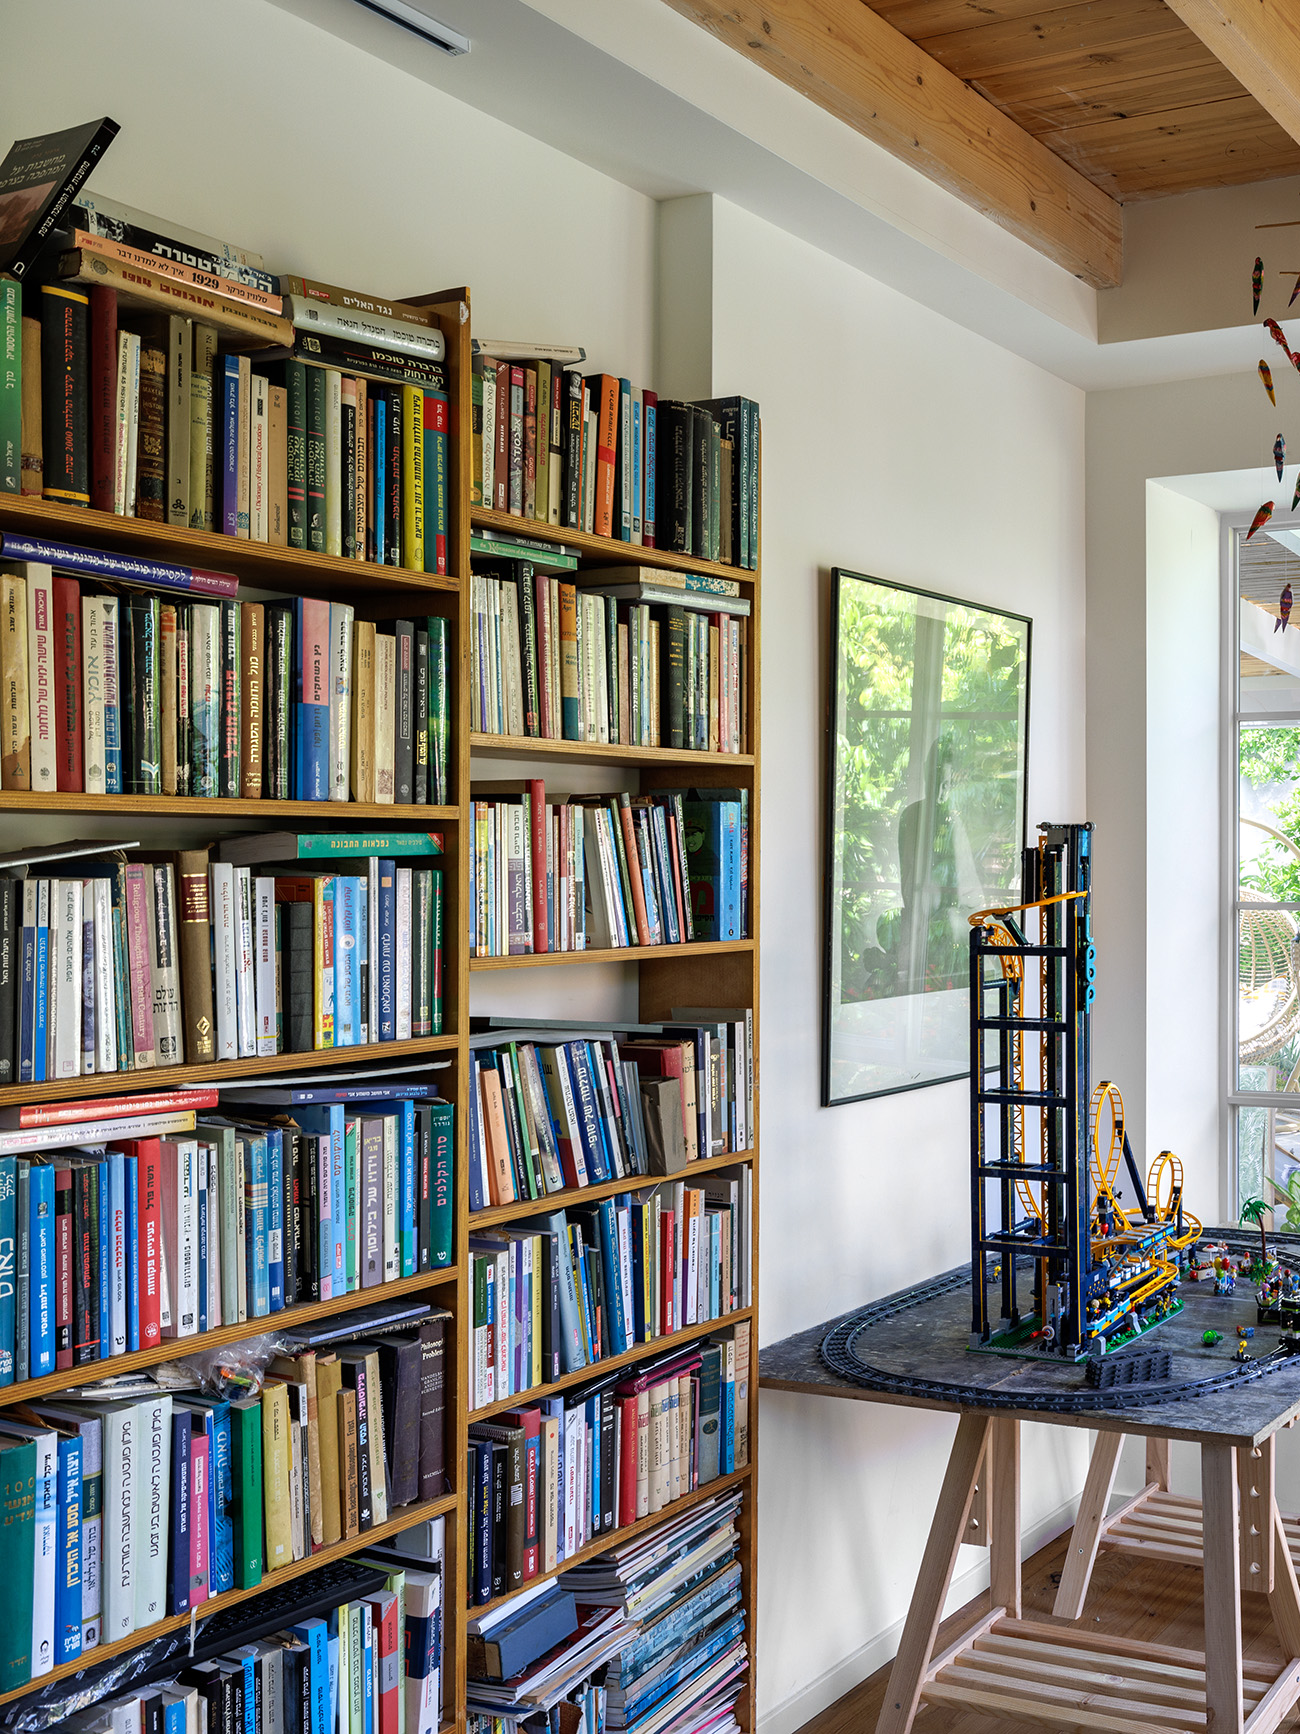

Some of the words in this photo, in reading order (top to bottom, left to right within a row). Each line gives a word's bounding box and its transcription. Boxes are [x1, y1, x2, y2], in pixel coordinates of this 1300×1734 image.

[71, 160, 90, 185] מחשבות
[68, 184, 75, 193] על
[51, 193, 70, 217] המהפכה
[38, 216, 54, 237] בצרפת
[117, 249, 132, 257] דבר
[134, 254, 156, 268] למדנו
[159, 262, 169, 271] לא
[172, 267, 184, 277] איך
[122, 271, 152, 288] 1914
[192, 272, 219, 289] 1929
[5, 288, 16, 304] מבוא
[160, 283, 214, 308] אוגוסט
[226, 285, 245, 297] פרקר
[222, 306, 248, 319] טוכמן
[343, 296, 374, 310] האלים
[376, 305, 392, 315] נגד
[5, 305, 17, 323] לחוקי
[251, 314, 277, 328] ברברה
[336, 317, 358, 329] הגאה
[362, 321, 386, 335] המגדל
[393, 330, 414, 342] טוכמן
[5, 325, 16, 360] ההיסטוריה
[417, 337, 440, 348] ברברה
[372, 351, 405, 365] טוכמן
[408, 360, 443, 373] ברברה
[121, 376, 126, 385] AS
[404, 368, 427, 380] רחוק
[428, 375, 444, 384] ראי
[65, 375, 75, 396] קיצור
[63, 398, 74, 429] תולדות
[65, 431, 73, 451] 2000
[512, 418, 523, 463] אלכסנדר
[256, 475, 263, 483] of
[355, 474, 364, 489] של
[37, 542, 69, 559] ישראל
[152, 568, 186, 582] לקסיקון
[37, 635, 46, 663] שישה
[38, 665, 47, 686] ימים
[88, 656, 101, 704] אומץ
[36, 689, 47, 703] של
[36, 705, 48, 740] מלחמה
[331, 840, 360, 848] התבונה
[363, 840, 389, 848] נפלאות
[512, 873, 522, 898] האלה
[132, 884, 141, 923] Religious
[512, 901, 522, 930] הלבנה
[133, 925, 143, 957] Thought
[135, 971, 143, 983] the
[156, 988, 174, 1000] עולם
[137, 1005, 146, 1037] Century
[577, 1067, 591, 1102] עולמה
[582, 1105, 593, 1122] של
[587, 1124, 597, 1148] סופי
[437, 1136, 447, 1156] סוד
[434, 1161, 449, 1206] הקלפים
[146, 1191, 154, 1210] פרל
[366, 1187, 377, 1207] של
[147, 1221, 155, 1256] בעיניים
[366, 1211, 378, 1259] פילוסוף
[147, 1259, 156, 1295] פקוחות
[121, 1421, 131, 1446] מילון
[346, 1420, 354, 1436] Frost
[359, 1423, 367, 1445] הבסיס
[151, 1434, 161, 1472] פונטנה
[67, 1451, 79, 1476] ניצה
[121, 1447, 131, 1487] פונטנה
[66, 1478, 79, 1503] אייל
[150, 1475, 160, 1512] לאישים
[67, 1503, 79, 1528] מסע
[121, 1489, 131, 1542] למחשבה
[150, 1514, 160, 1530] בני
[348, 1512, 356, 1529] Basic
[66, 1529, 79, 1548] אל
[87, 1526, 96, 1540] בתו
[85, 1543, 96, 1558] של
[150, 1532, 160, 1558] זמננו
[67, 1548, 81, 1588] הזיכרון
[121, 1544, 130, 1586] מודרנית
[85, 1561, 96, 1590] גלילאו
[352, 1676, 360, 1695] במבחן
